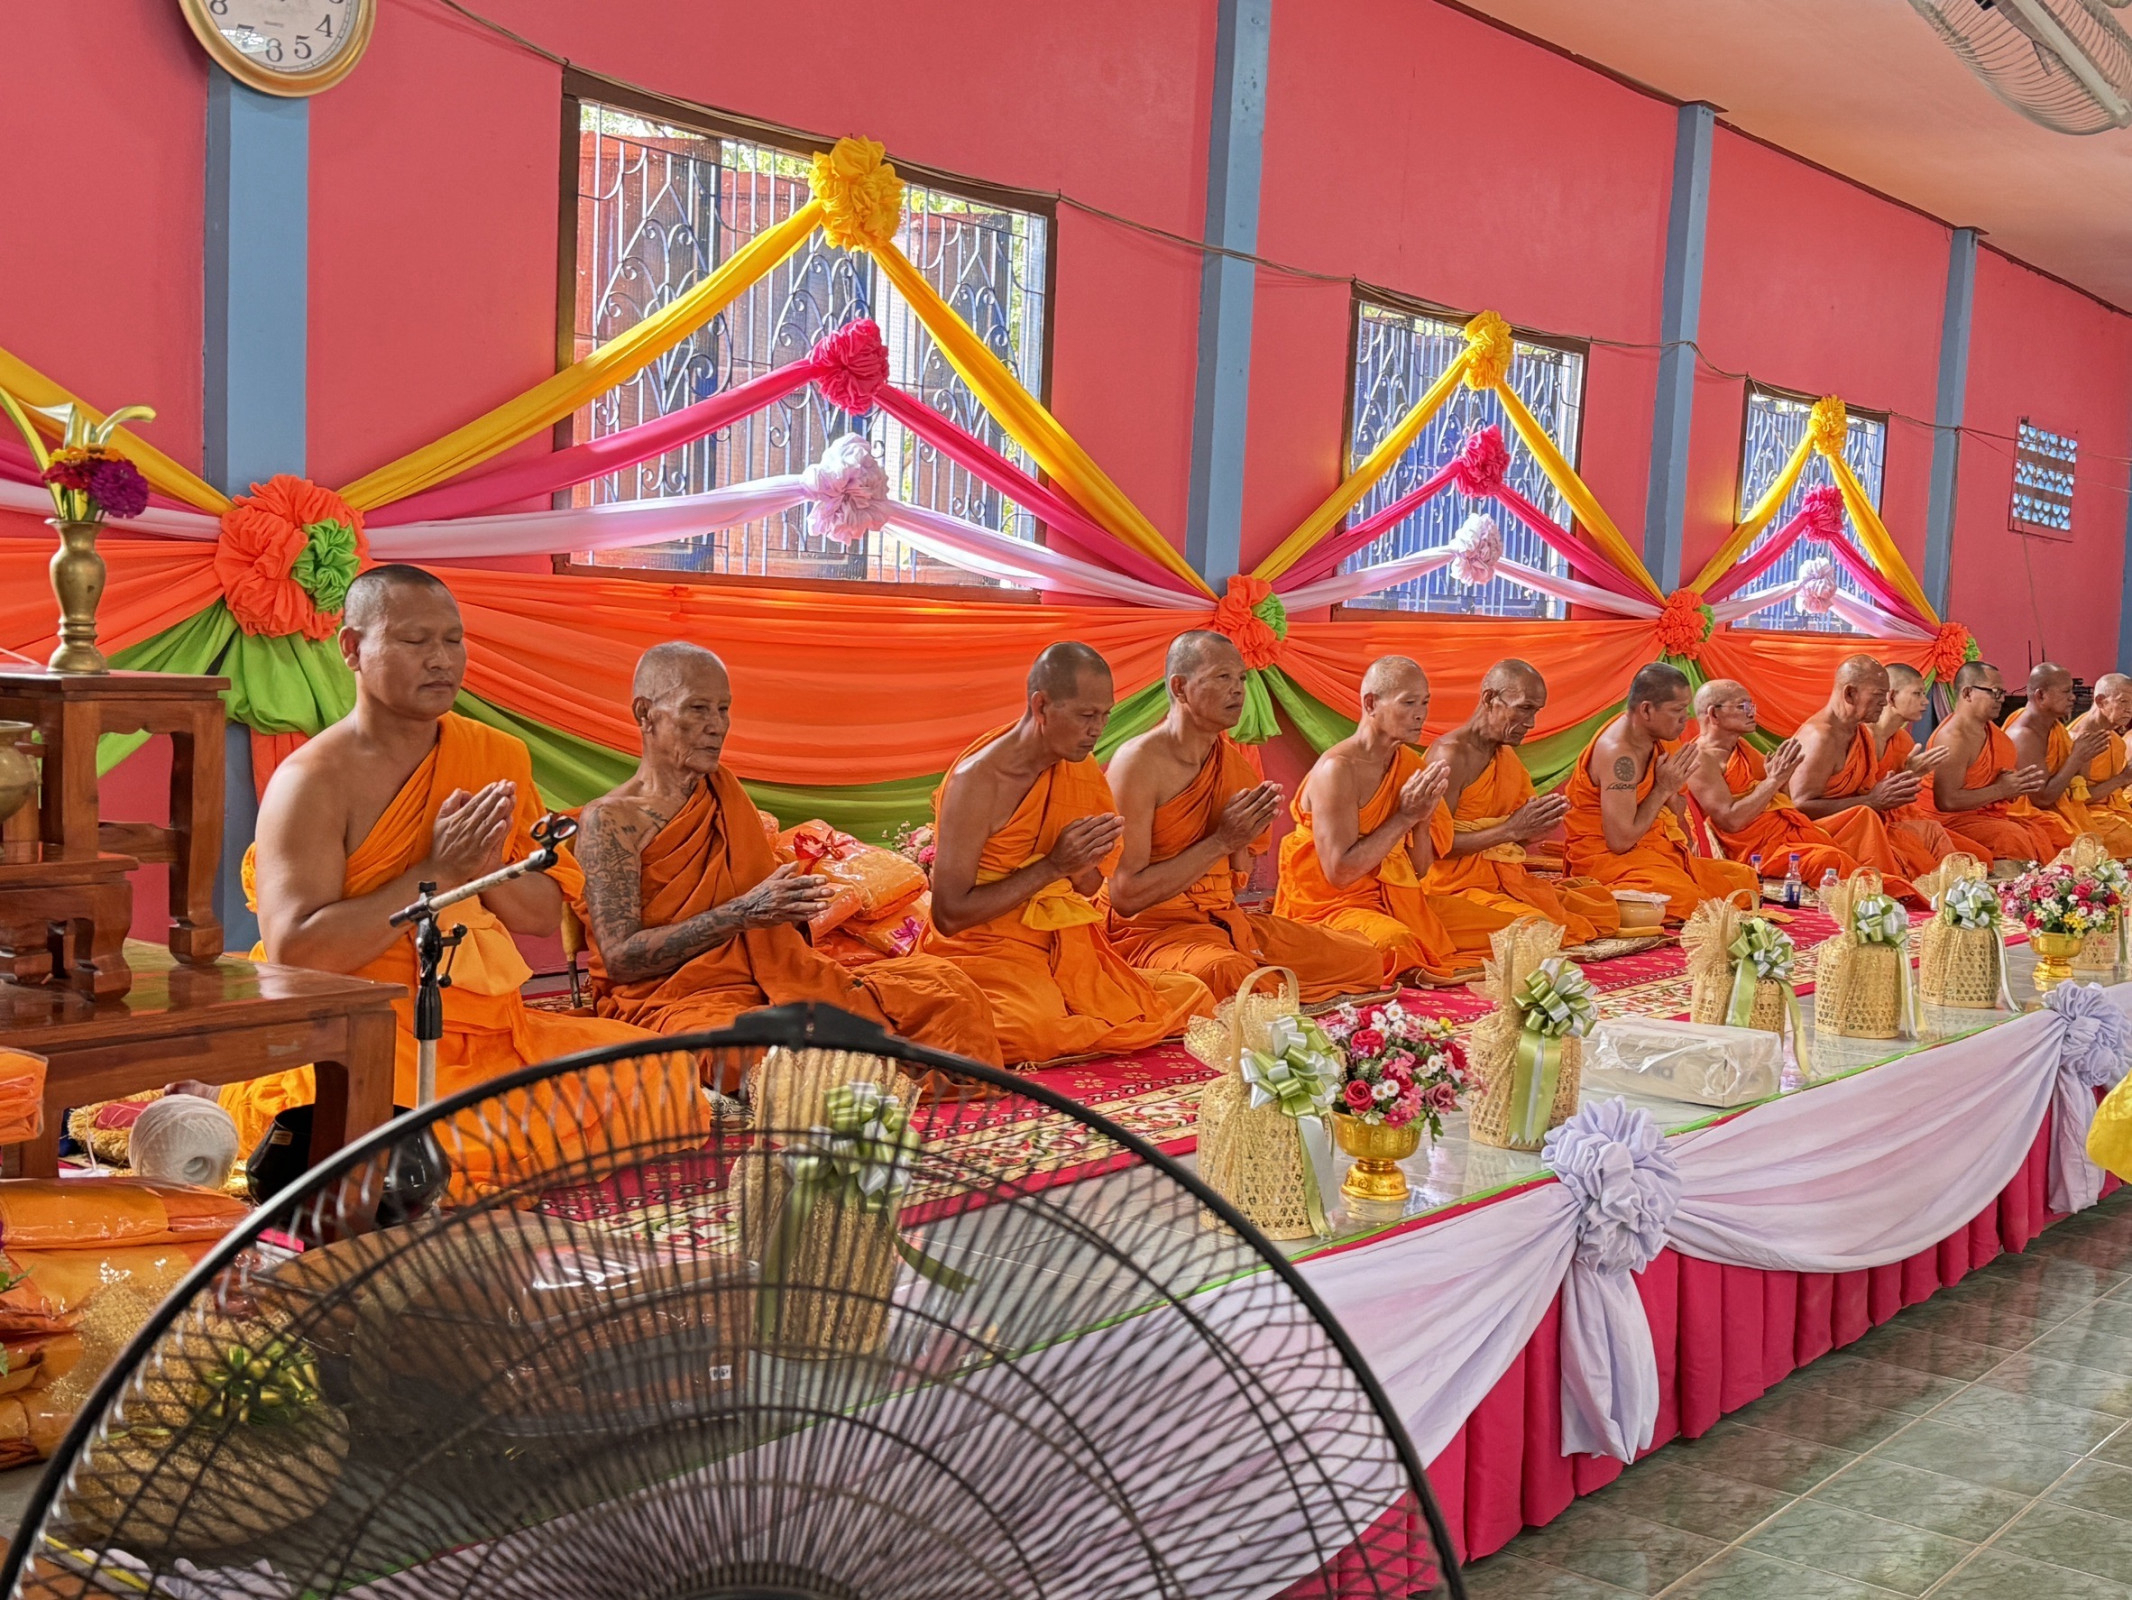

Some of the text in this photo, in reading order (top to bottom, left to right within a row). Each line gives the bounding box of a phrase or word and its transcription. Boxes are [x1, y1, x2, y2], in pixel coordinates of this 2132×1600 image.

[210, 0, 228, 15] 8
[236, 24, 254, 48] 7
[315, 14, 333, 38] 4
[266, 38, 283, 62] 6
[294, 35, 312, 59] 5
